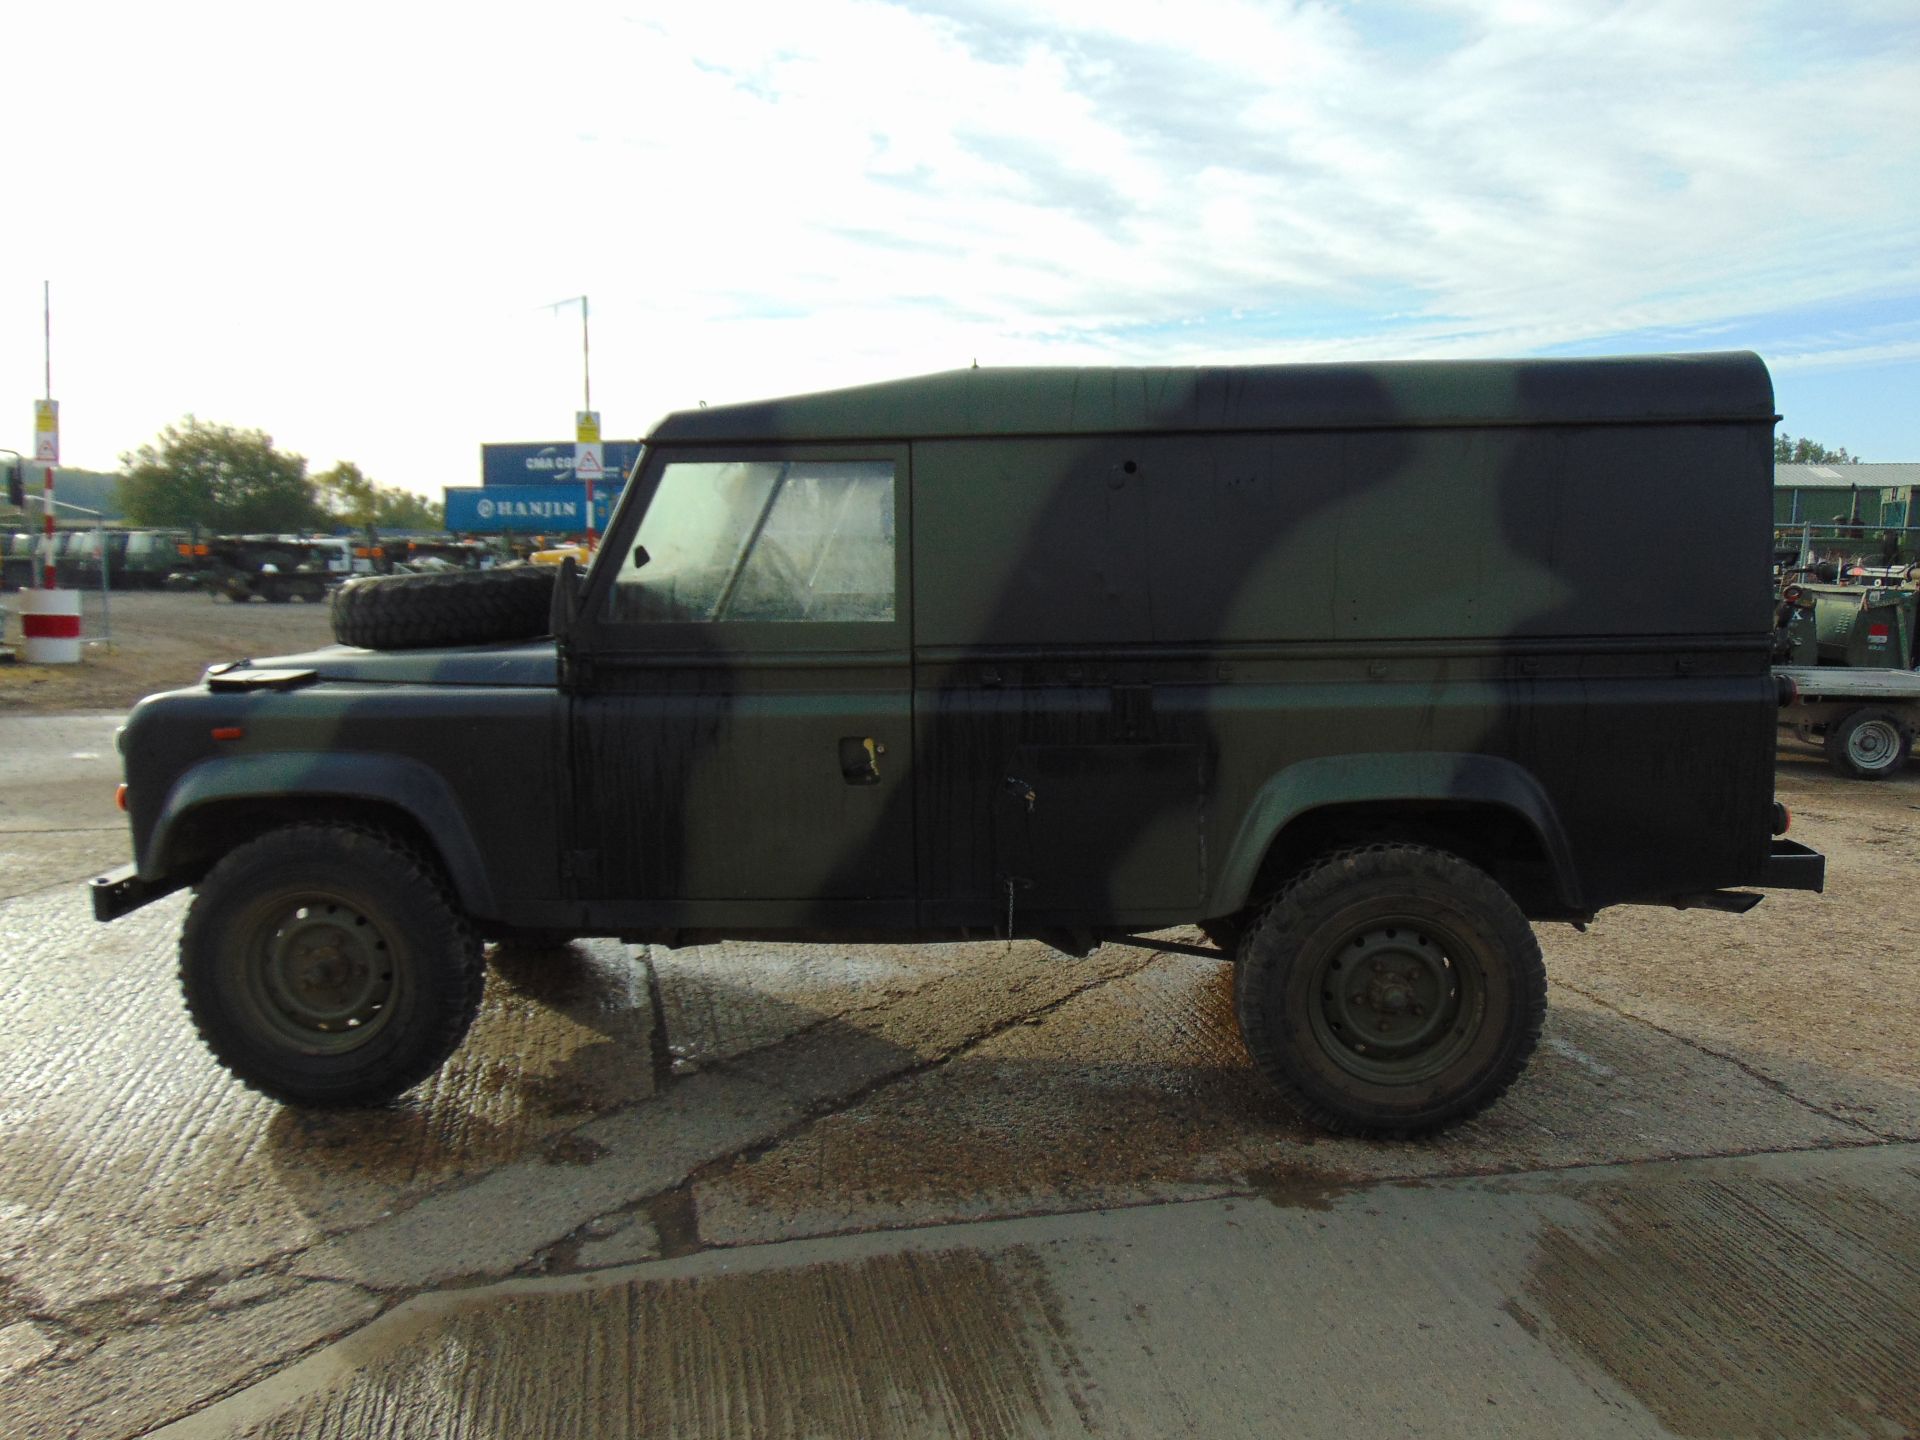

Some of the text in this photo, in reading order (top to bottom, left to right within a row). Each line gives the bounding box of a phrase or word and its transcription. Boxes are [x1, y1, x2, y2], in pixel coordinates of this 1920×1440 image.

[526, 457, 576, 469] CMA CG
[497, 502, 576, 517] HANJIN
